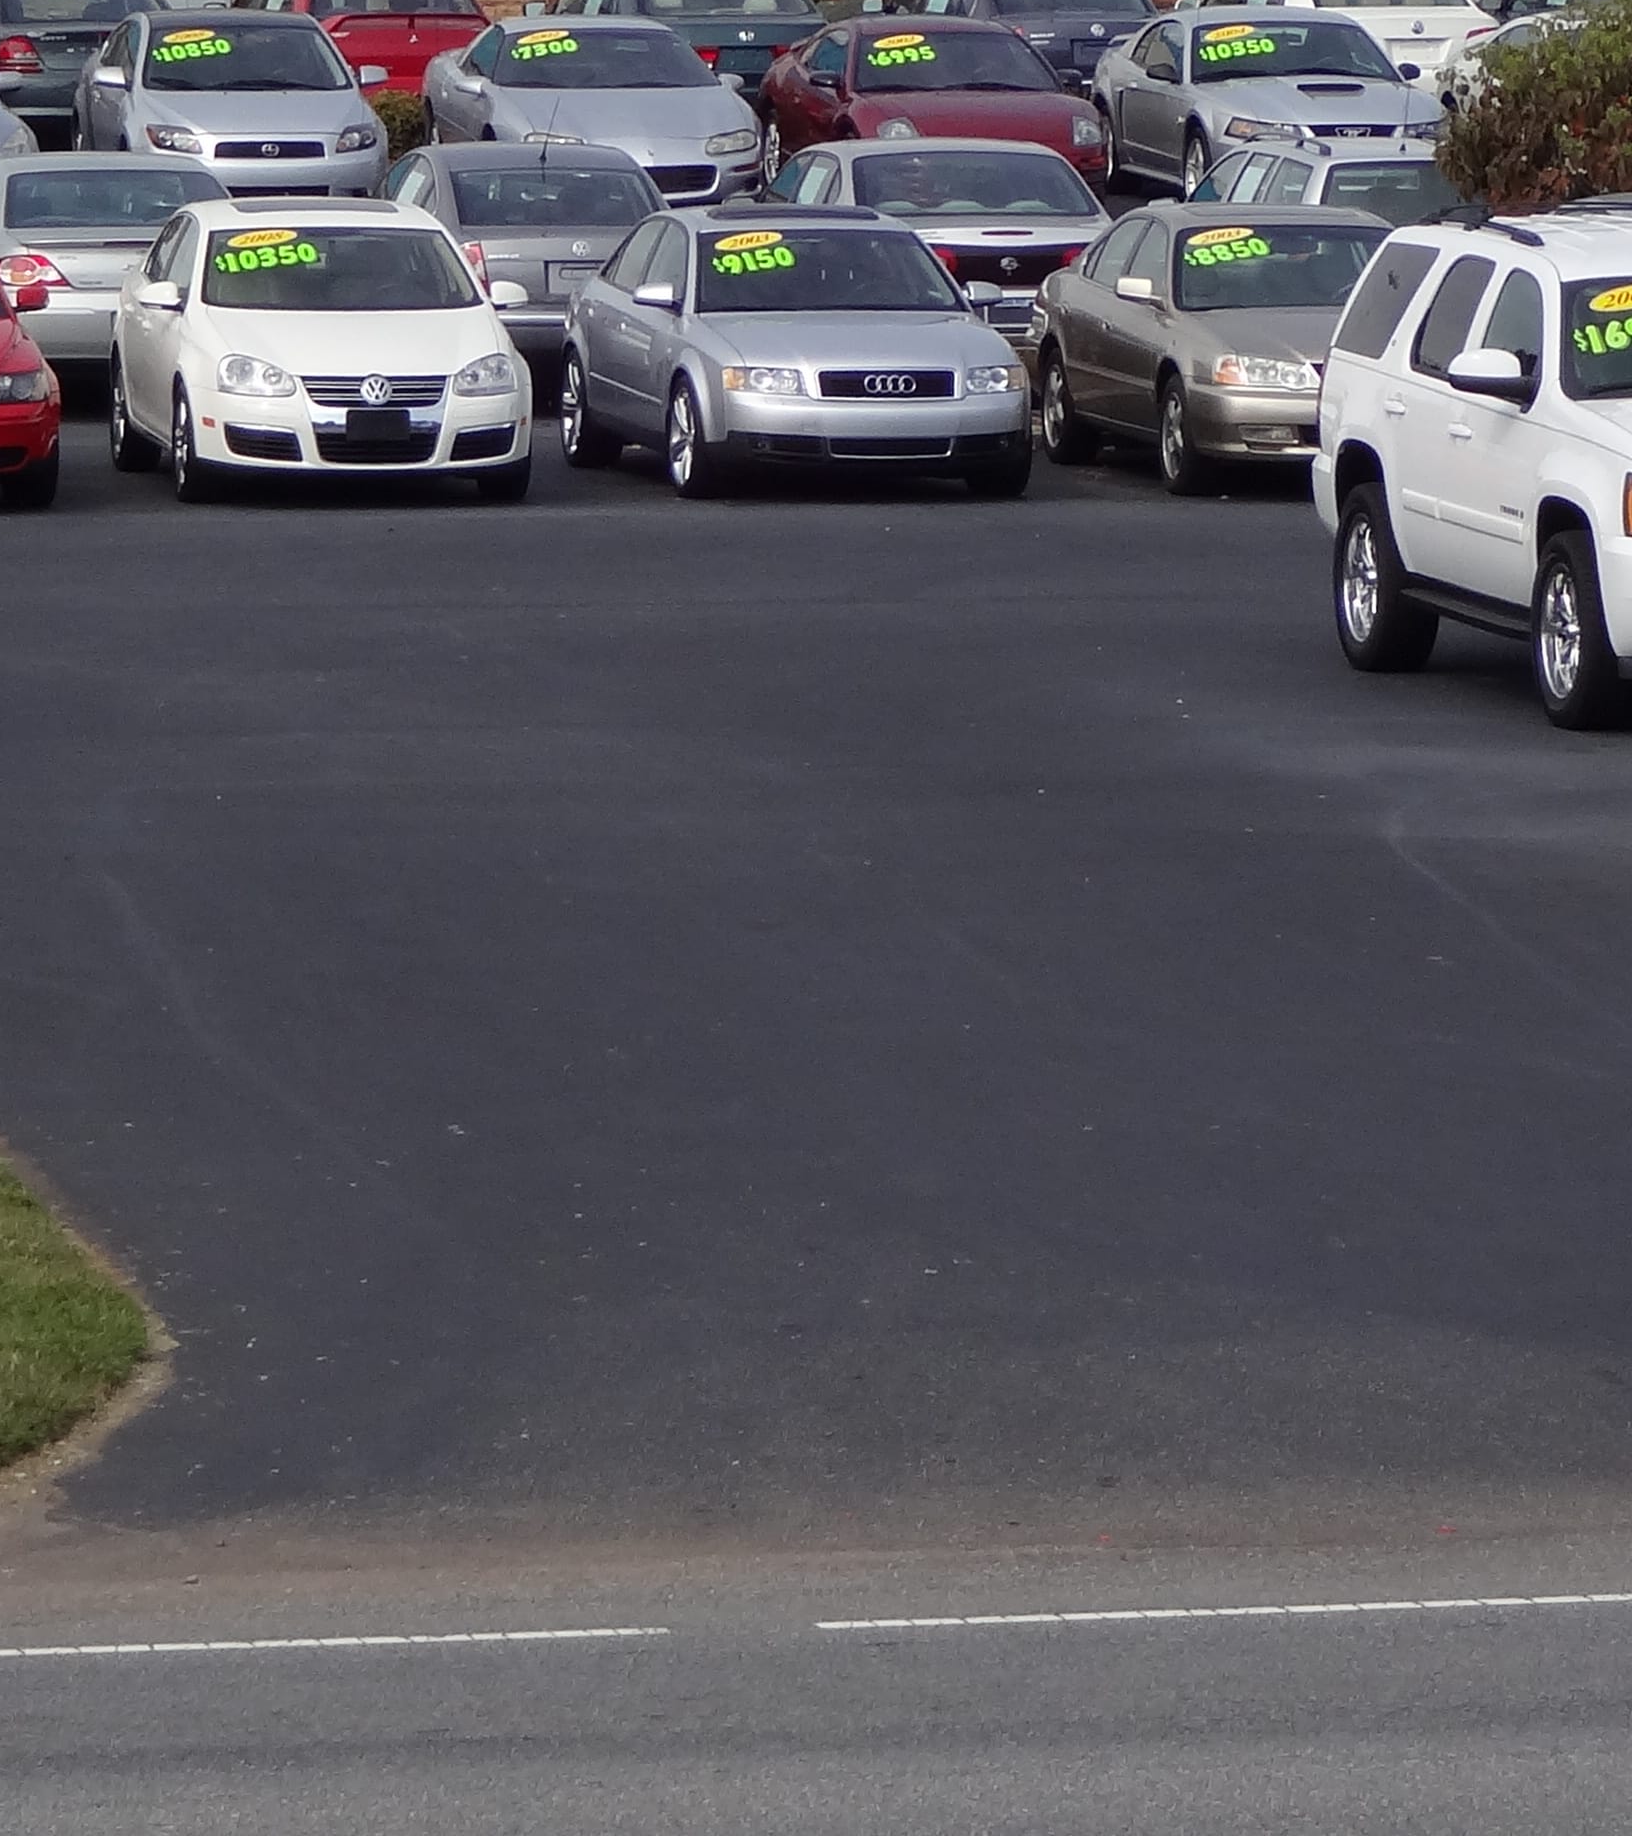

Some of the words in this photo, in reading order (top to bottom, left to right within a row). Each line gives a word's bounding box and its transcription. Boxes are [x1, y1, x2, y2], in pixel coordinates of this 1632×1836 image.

[152, 39, 231, 62] $10850
[511, 39, 578, 59] $7300
[868, 45, 936, 65] $6995
[1199, 38, 1276, 61] $10350
[214, 242, 319, 273] $10350
[712, 246, 795, 275] $9150
[1184, 237, 1270, 266] $8850
